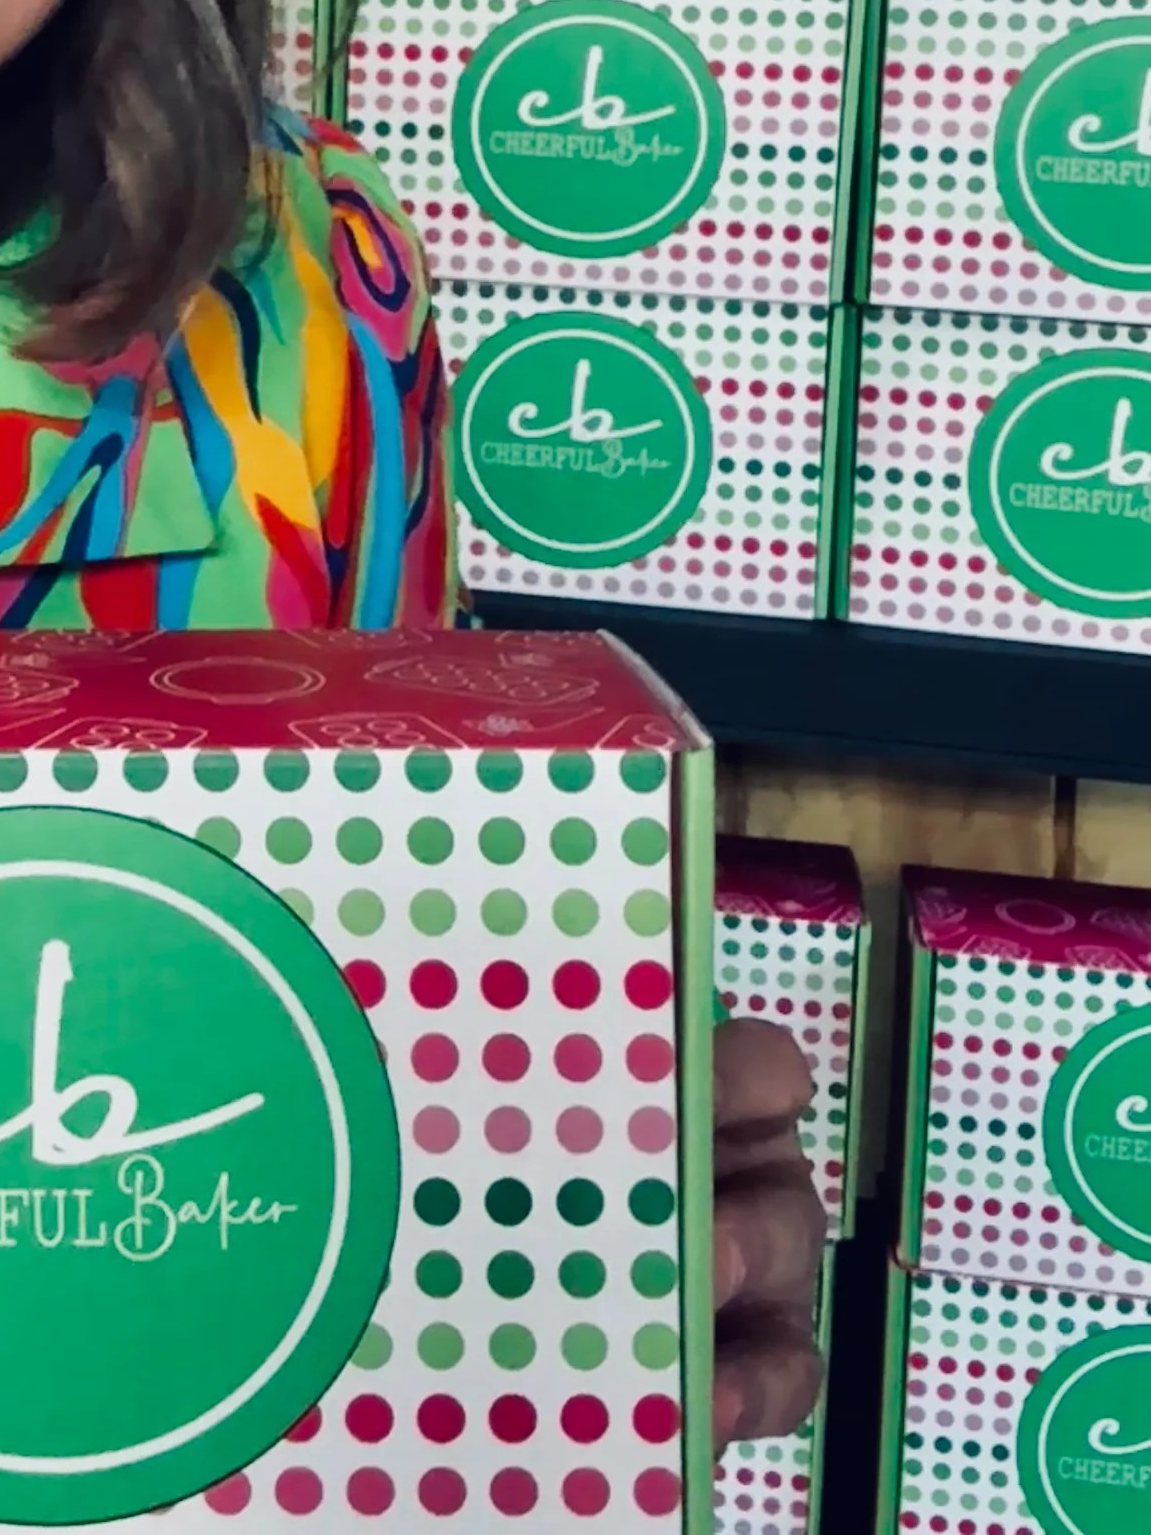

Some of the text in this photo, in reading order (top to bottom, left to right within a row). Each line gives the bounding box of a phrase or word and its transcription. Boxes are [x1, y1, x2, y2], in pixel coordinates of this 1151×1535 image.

[517, 45, 676, 130] cb
[489, 130, 612, 161] CHEERFUL
[1036, 155, 1151, 187] CHEERFU
[508, 359, 663, 442] cb
[481, 441, 602, 472] CHEERFUL
[1009, 482, 1139, 518] CHEERFUL
[113, 1153, 298, 1262] Baker
